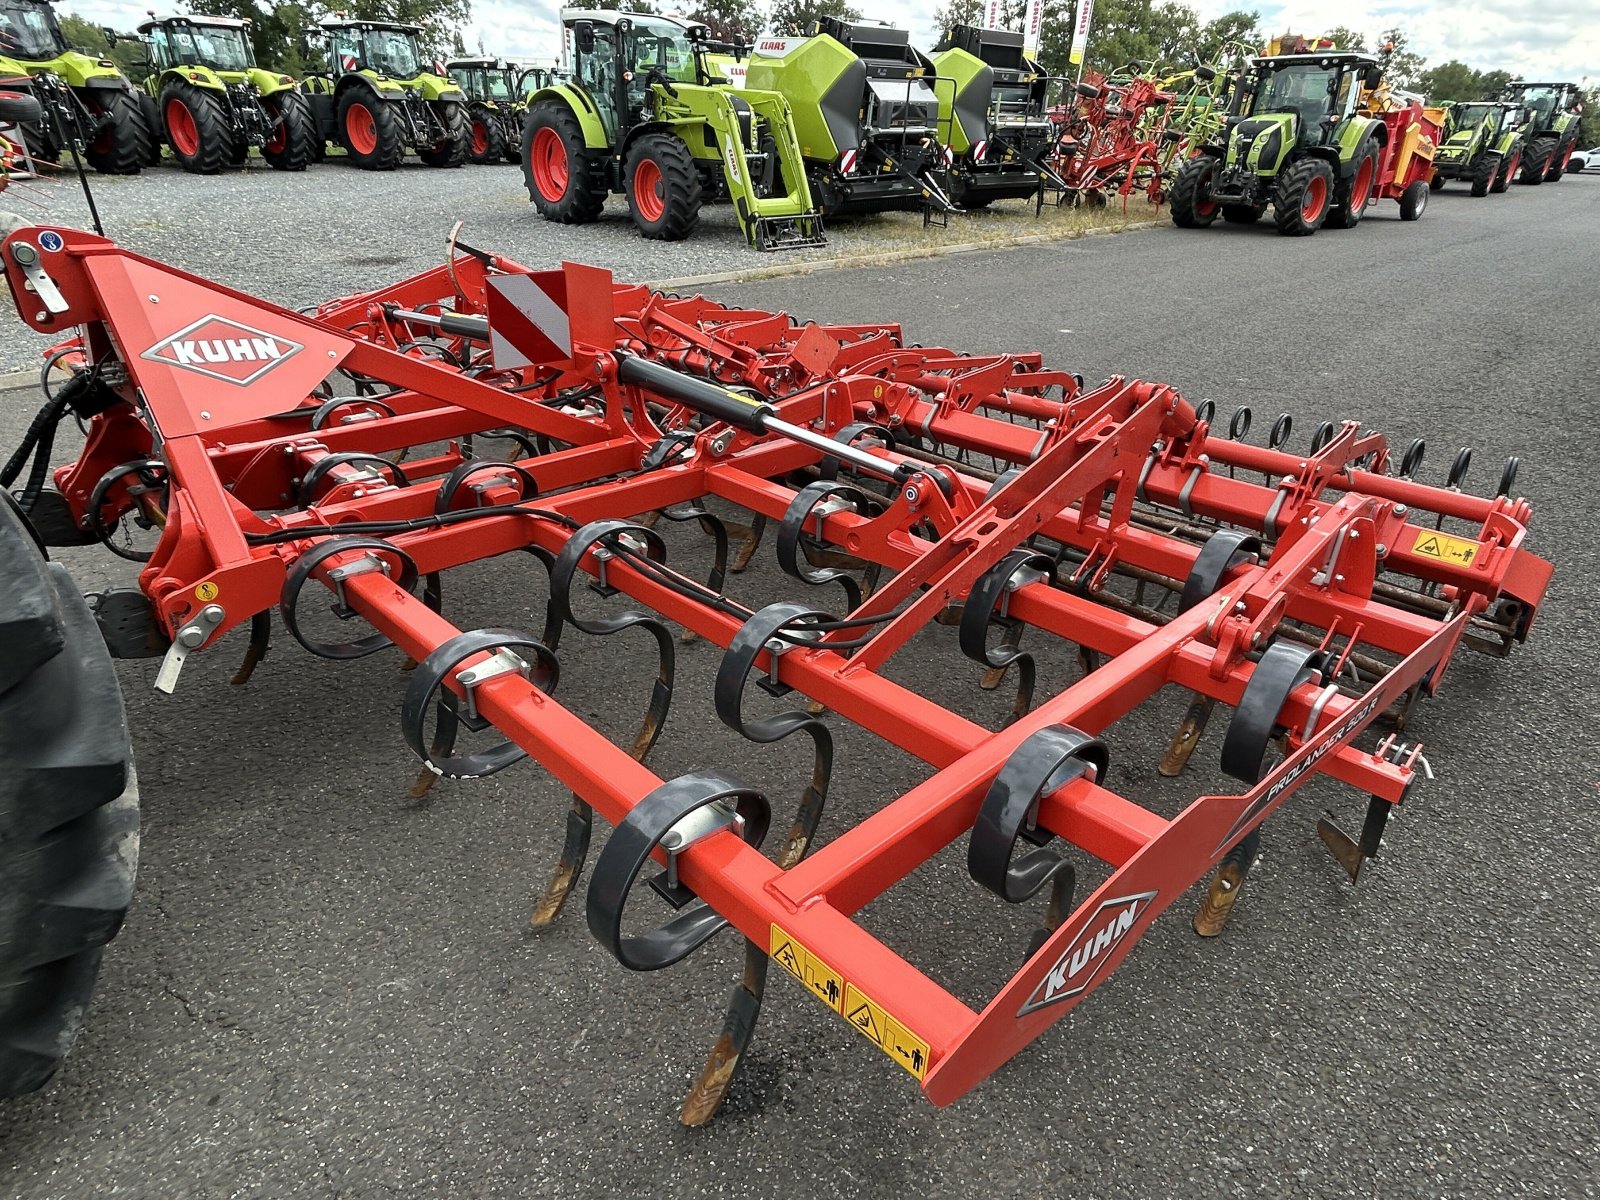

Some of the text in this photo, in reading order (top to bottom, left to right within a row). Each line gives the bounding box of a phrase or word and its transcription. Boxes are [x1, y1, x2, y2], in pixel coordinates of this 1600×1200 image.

[760, 41, 786, 50] CLAAS
[730, 67, 747, 76] CLA
[728, 149, 738, 176] CLAAS
[170, 337, 282, 364] KUHN
[1266, 697, 1378, 801] PROLANDER 500 R
[1044, 899, 1138, 1002] KUHN
